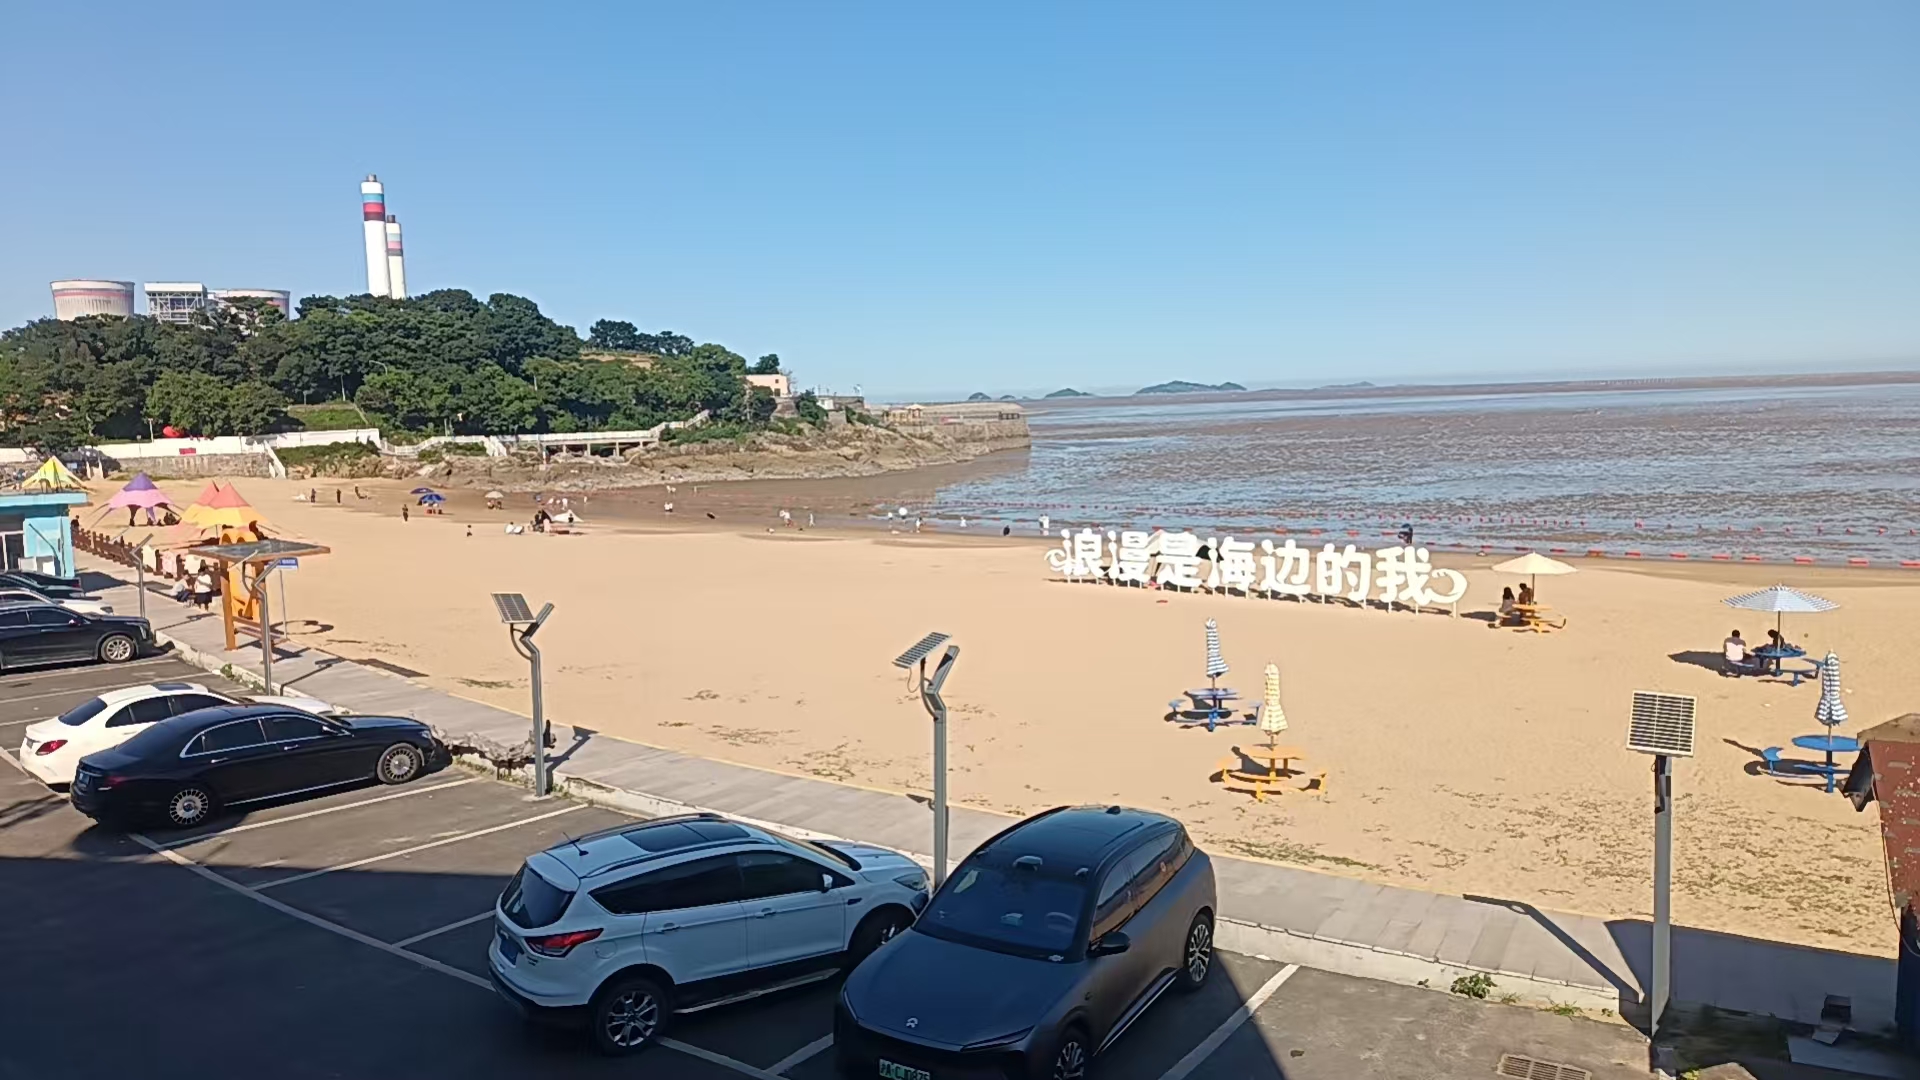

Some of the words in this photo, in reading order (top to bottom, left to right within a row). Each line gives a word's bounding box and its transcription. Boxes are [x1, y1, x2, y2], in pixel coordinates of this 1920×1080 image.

[1059, 527, 1434, 605] 浪漫是海边的我
